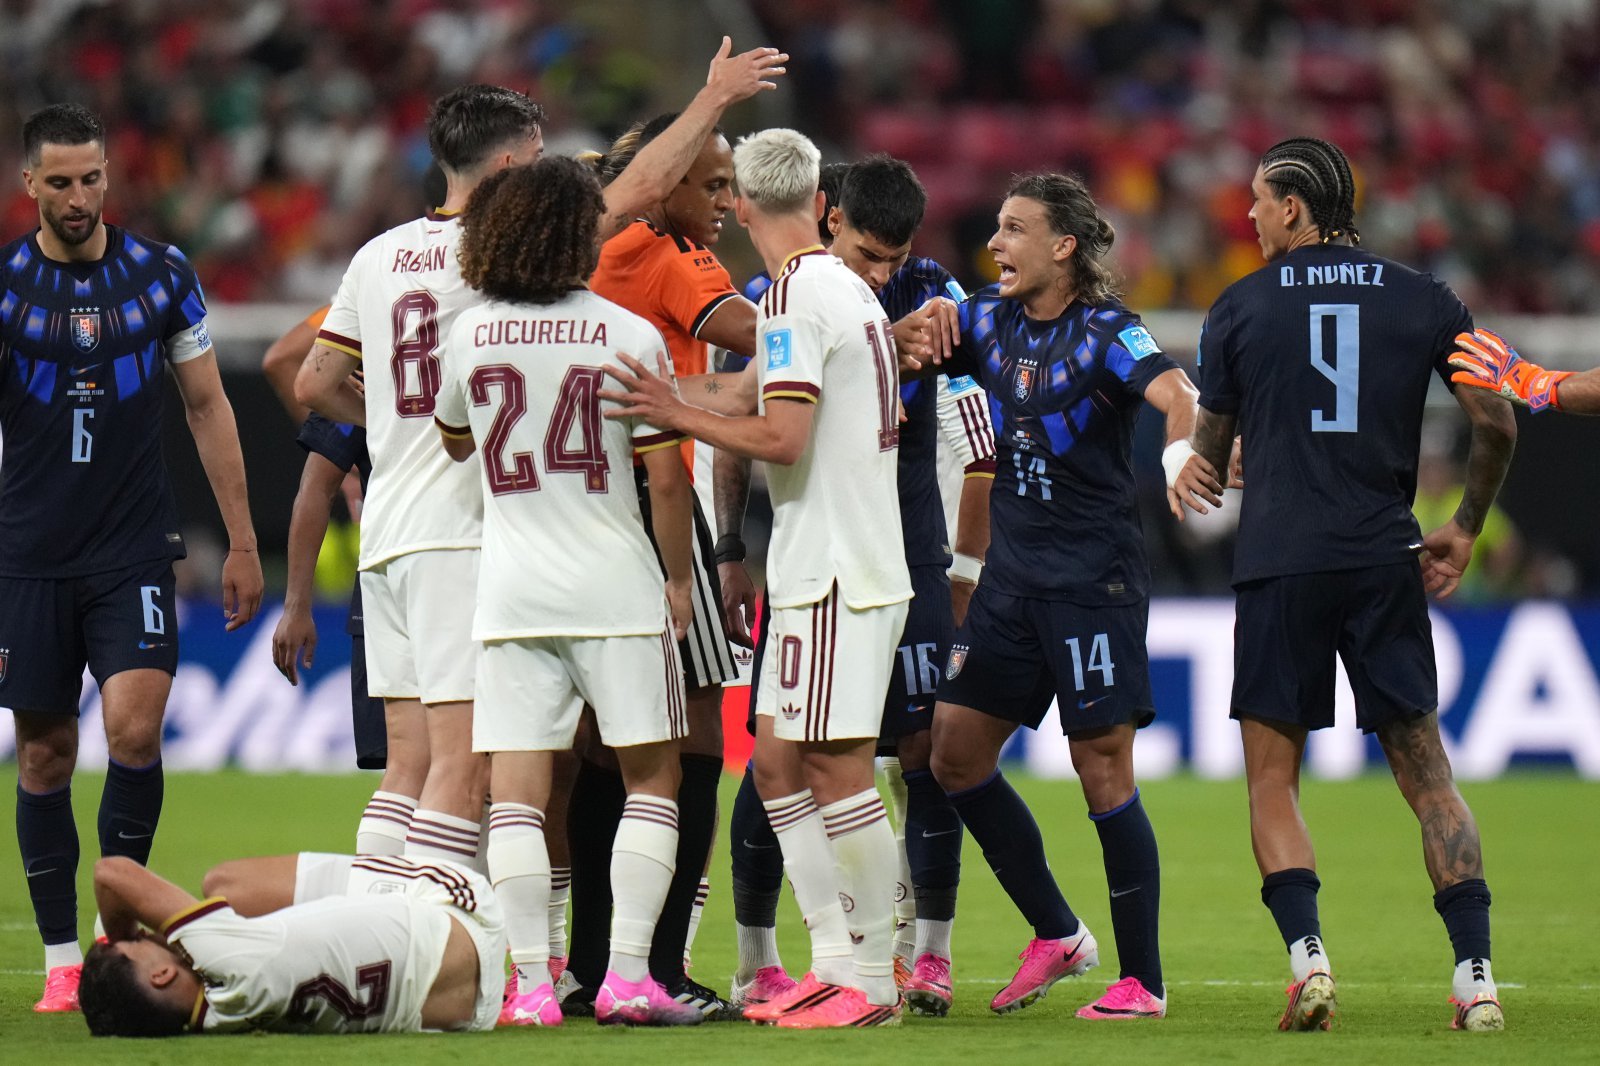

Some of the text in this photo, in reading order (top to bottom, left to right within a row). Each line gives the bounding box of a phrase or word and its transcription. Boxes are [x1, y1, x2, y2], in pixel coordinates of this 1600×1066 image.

[694, 255, 715, 266] FIF
[1280, 262, 1384, 287] D. NUÑEZ
[390, 290, 441, 418] 8
[474, 320, 608, 348] CUCURELLA
[1309, 304, 1360, 433] 9
[72, 408, 95, 463] 6
[468, 364, 610, 497] 24
[140, 586, 165, 634] 6
[777, 634, 803, 690] 0
[896, 642, 940, 696] 16
[1064, 633, 1115, 691] 14
